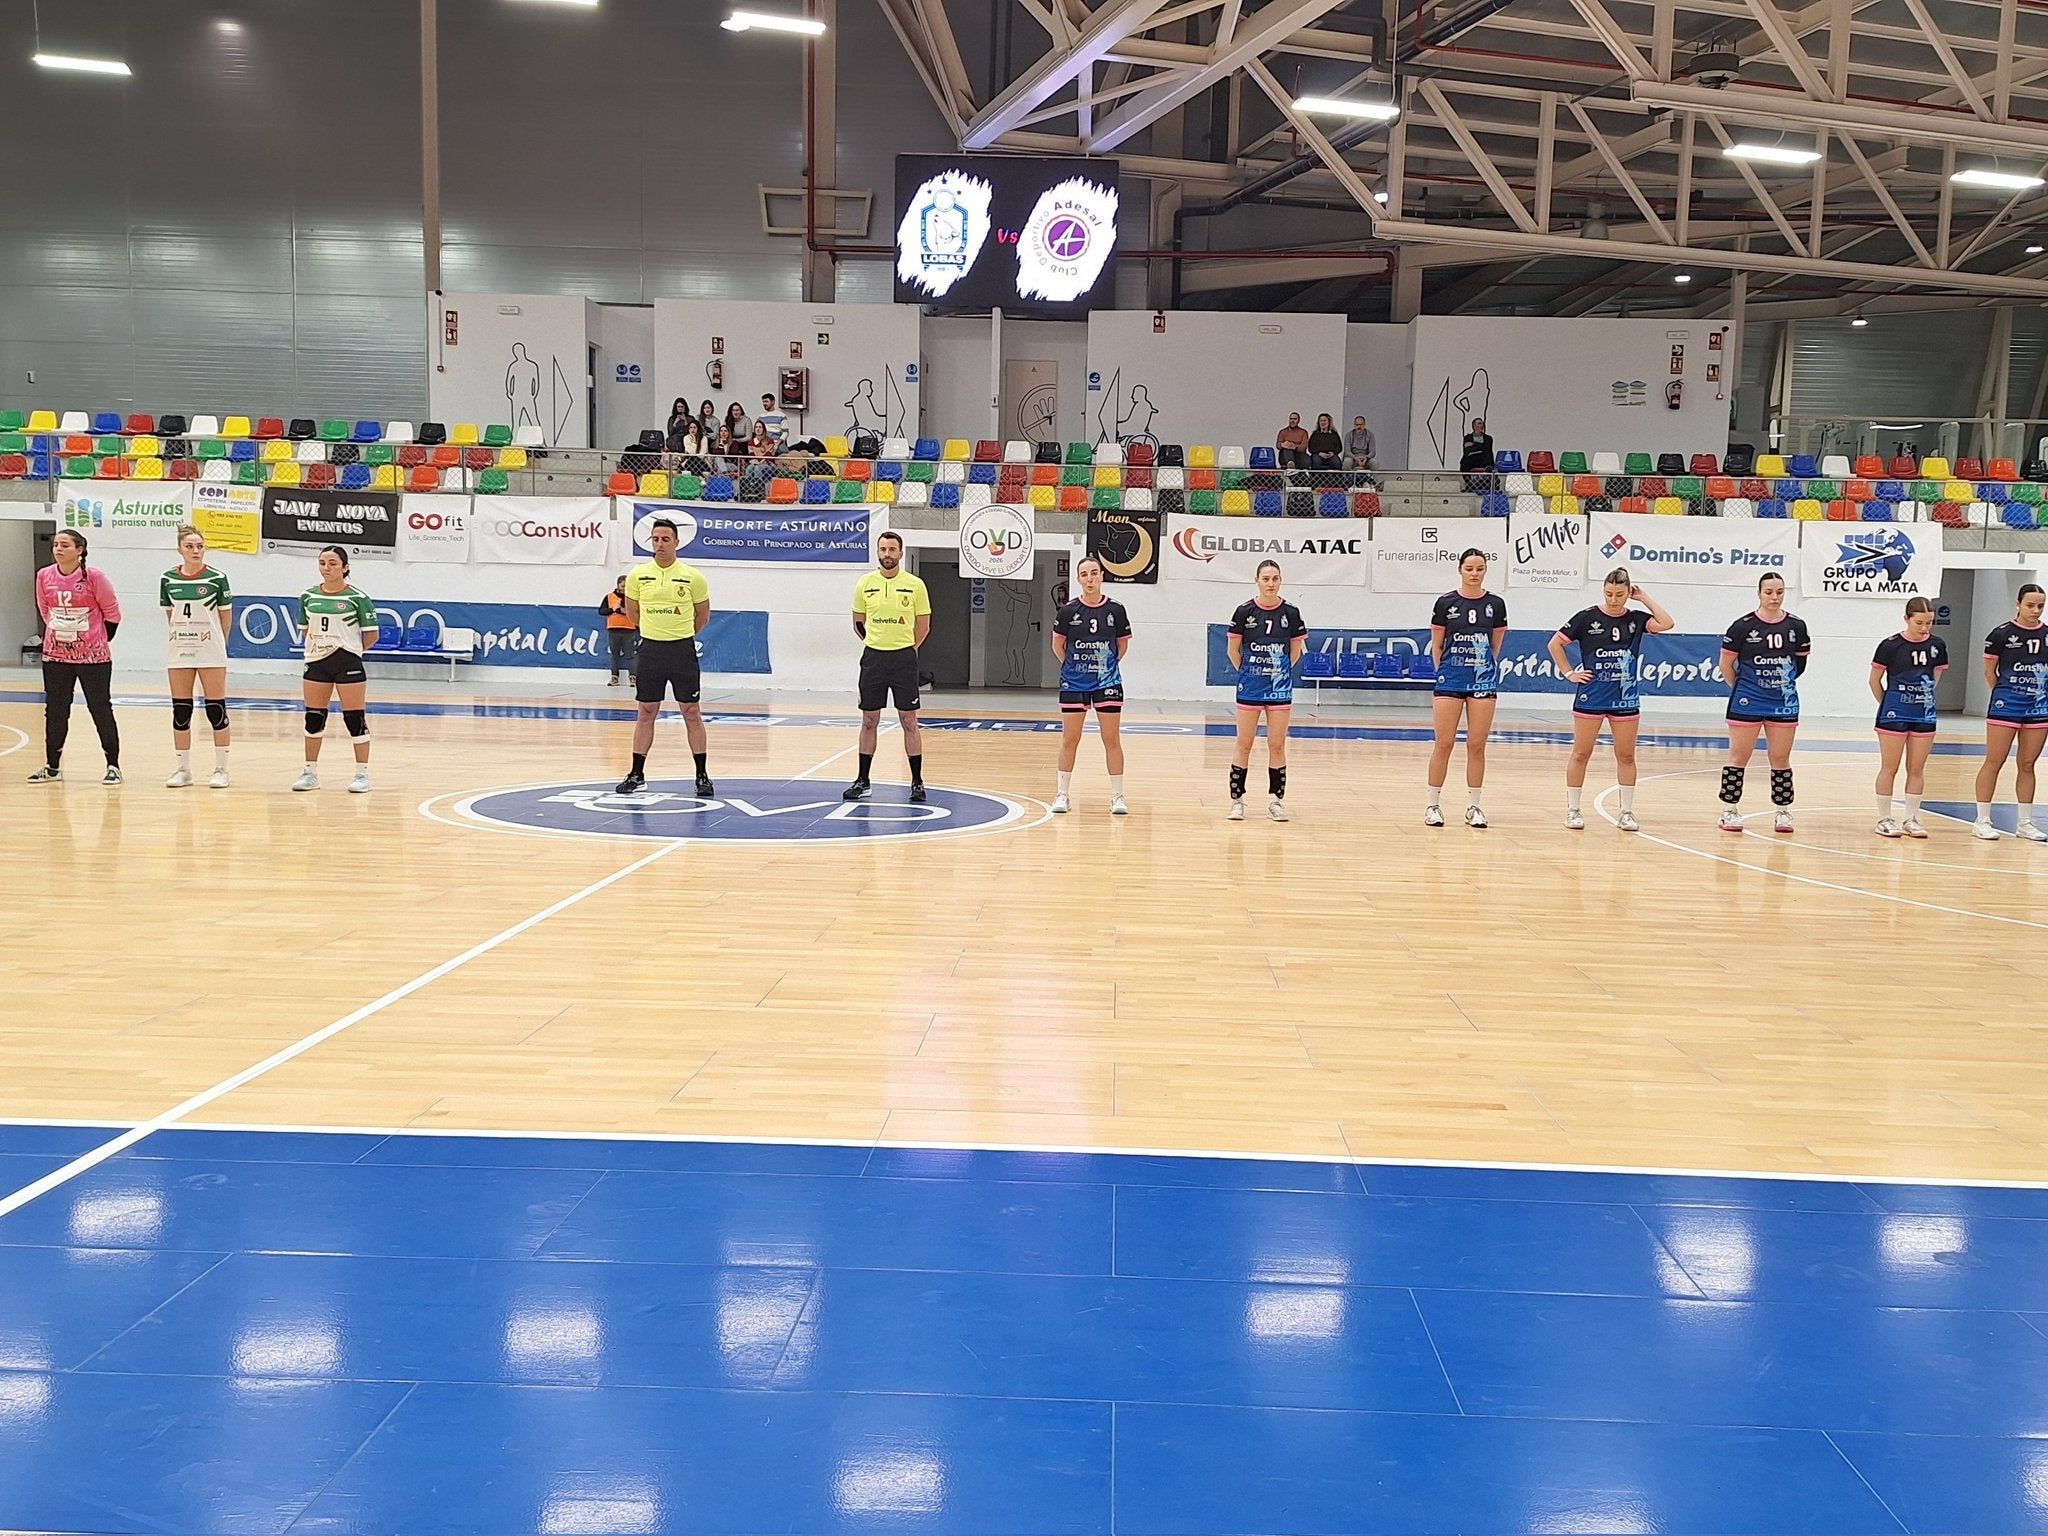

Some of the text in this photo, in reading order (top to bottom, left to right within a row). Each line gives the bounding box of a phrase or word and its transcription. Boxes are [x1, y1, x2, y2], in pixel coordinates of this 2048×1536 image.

[1054, 200, 1102, 227] Adesal
[922, 254, 966, 264] LOBAS
[112, 499, 184, 516] Asturias
[272, 499, 321, 518] JAVI
[703, 518, 867, 532] DEPORTE ASTURIANO
[1091, 510, 1130, 524] Moon
[296, 519, 364, 535] EVENTOS
[702, 536, 744, 547] GOBIERNO
[747, 539, 760, 547] DEL
[764, 539, 812, 549] PRINCIPADO
[828, 540, 867, 549] ASTURIAS
[1201, 535, 1362, 554] GLOBAL ATAC
[1515, 518, 1580, 565] El Mito
[964, 545, 982, 568] OVIEDO
[982, 565, 997, 574] VIVE
[1006, 545, 1029, 572] DEPORTE
[1629, 544, 1784, 567] Domino's Pizza
[1532, 568, 1551, 576] Pedro
[1823, 567, 1878, 579] GRUPO
[1822, 580, 1919, 593] TYC LA MATA
[57, 590, 72, 607] 12
[183, 603, 192, 619] 4
[1468, 609, 1477, 624] 8
[321, 616, 329, 632] 9
[1089, 619, 1098, 633] 3
[1265, 620, 1273, 634] 7
[556, 626, 600, 656] del
[1611, 627, 1620, 642] 9
[1766, 633, 1783, 649] 10
[2026, 639, 2041, 654] 17
[1911, 650, 1928, 666] 14
